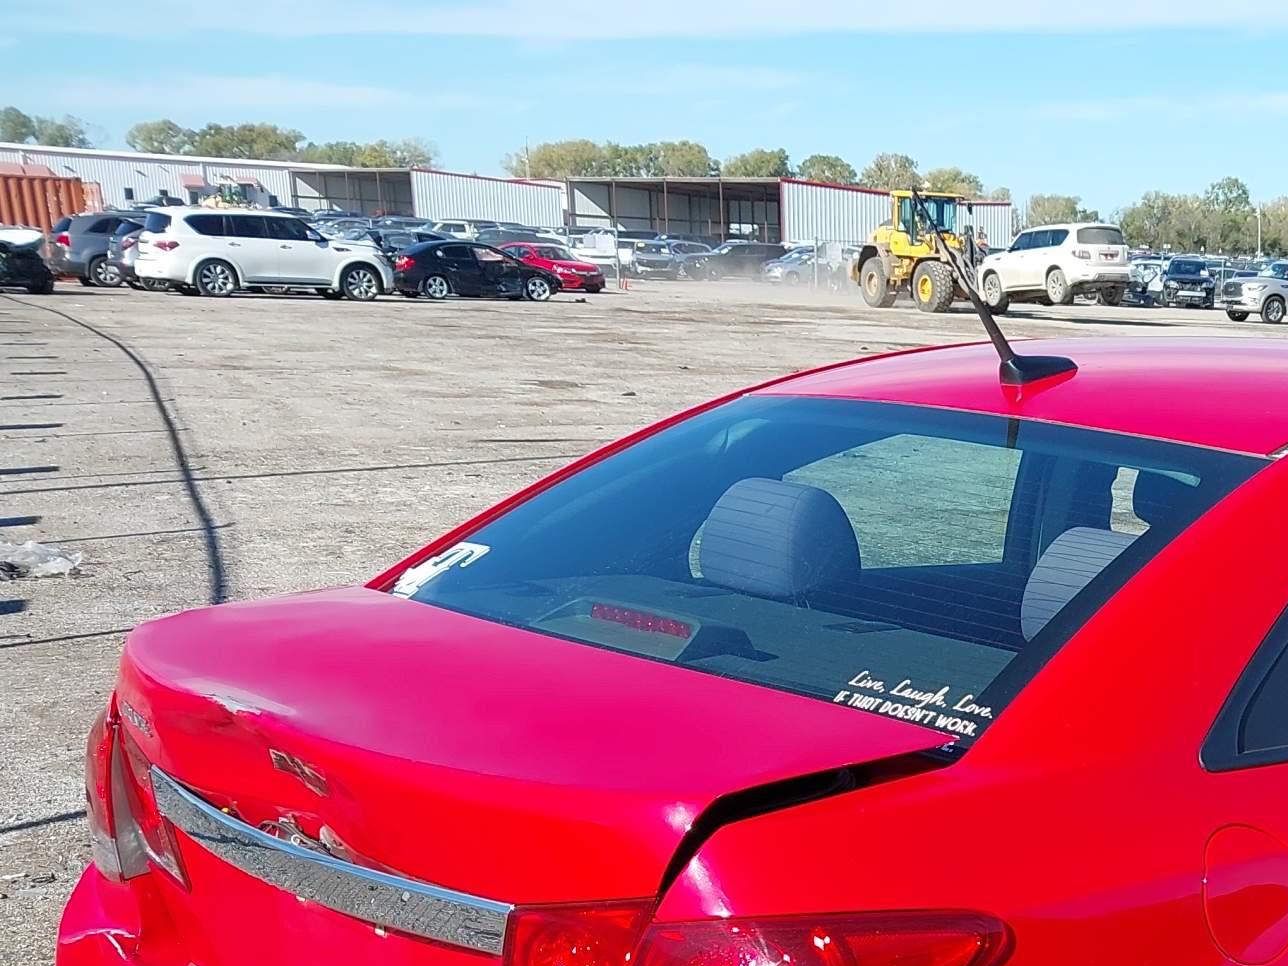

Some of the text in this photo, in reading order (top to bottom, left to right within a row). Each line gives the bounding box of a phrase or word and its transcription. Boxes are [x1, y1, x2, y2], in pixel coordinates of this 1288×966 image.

[833, 690, 978, 737] IF THAT DOESN'T WORK.
[847, 670, 886, 694] Live,
[952, 694, 993, 719] Love.
